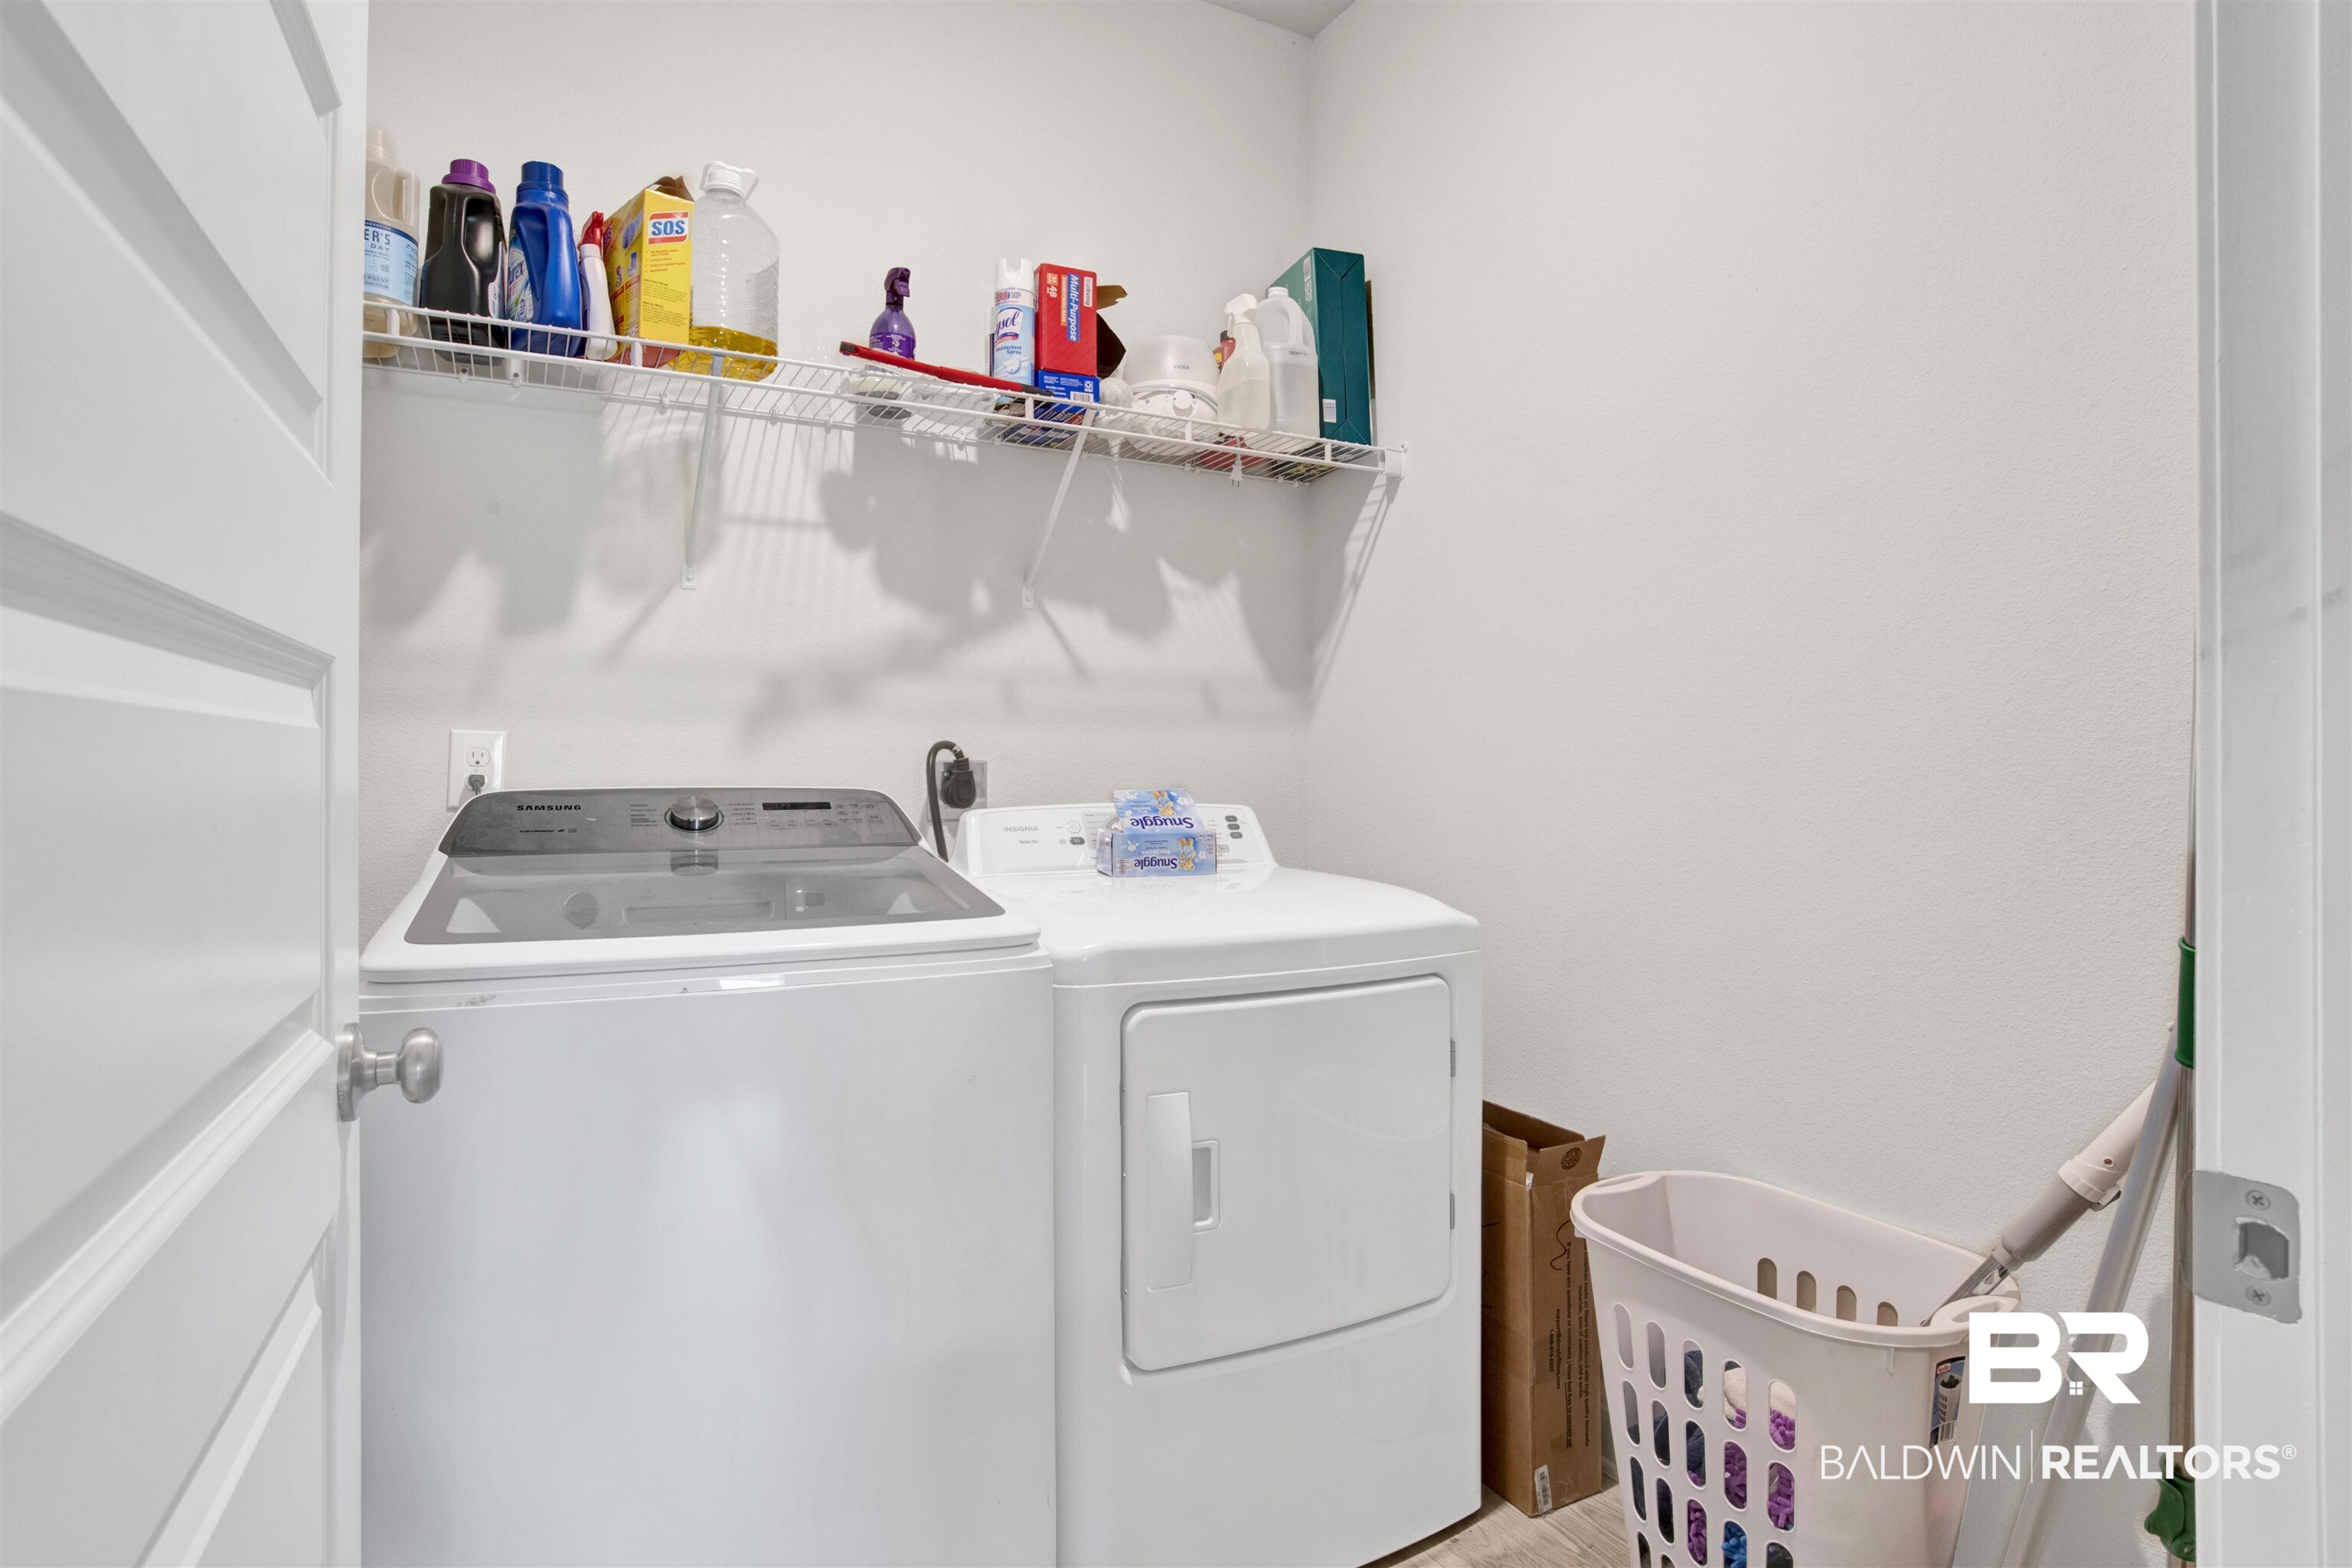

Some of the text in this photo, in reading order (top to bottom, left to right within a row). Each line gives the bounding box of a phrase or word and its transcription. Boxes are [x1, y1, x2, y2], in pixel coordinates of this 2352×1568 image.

[371, 243, 390, 252] DAY
[1050, 286, 1057, 298] 48
[1068, 274, 1080, 341] Multi-Purpose
[1129, 816, 1194, 829] Snuggle
[1134, 856, 1178, 870] Snuggle
